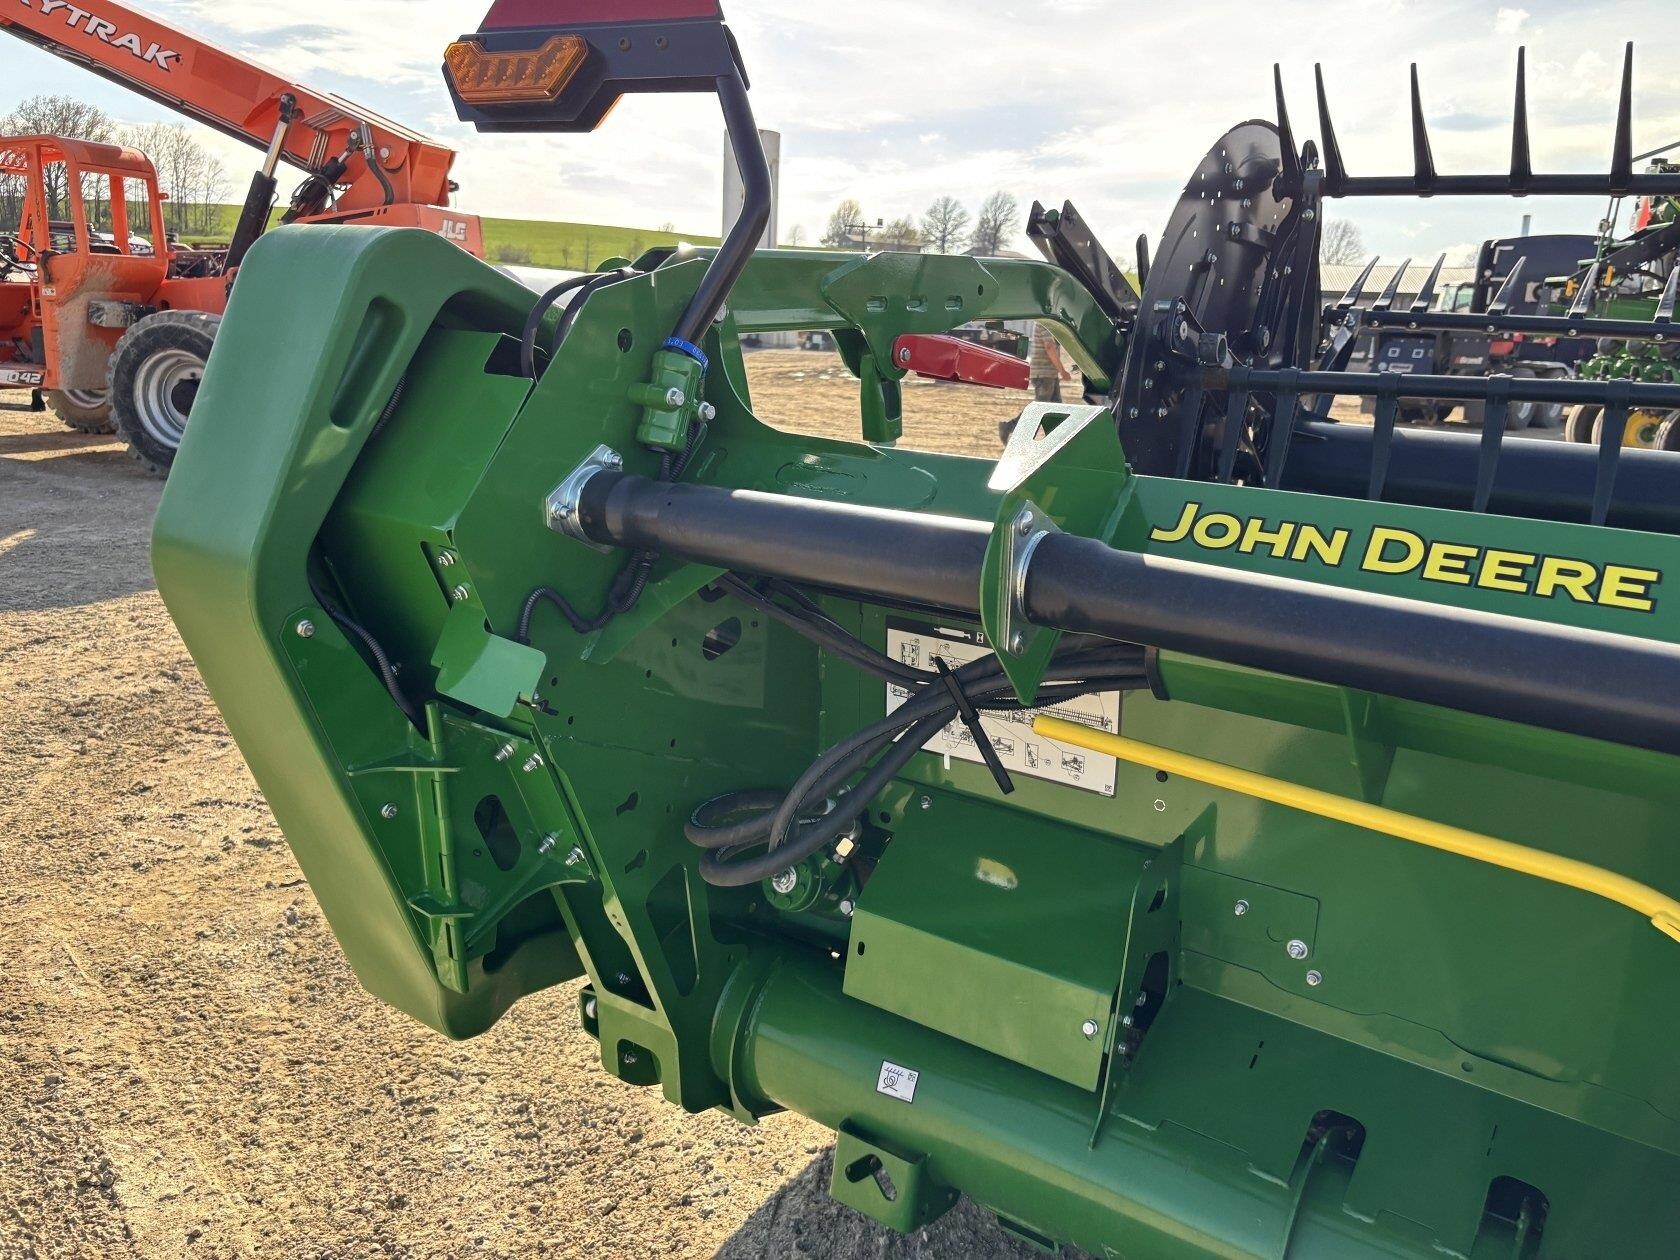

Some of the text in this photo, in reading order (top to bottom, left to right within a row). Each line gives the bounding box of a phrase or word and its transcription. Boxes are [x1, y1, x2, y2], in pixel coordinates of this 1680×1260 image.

[20, 0, 181, 72] YTRAK
[438, 219, 467, 241] JLG
[1150, 502, 1662, 612] JOHN DEERE
